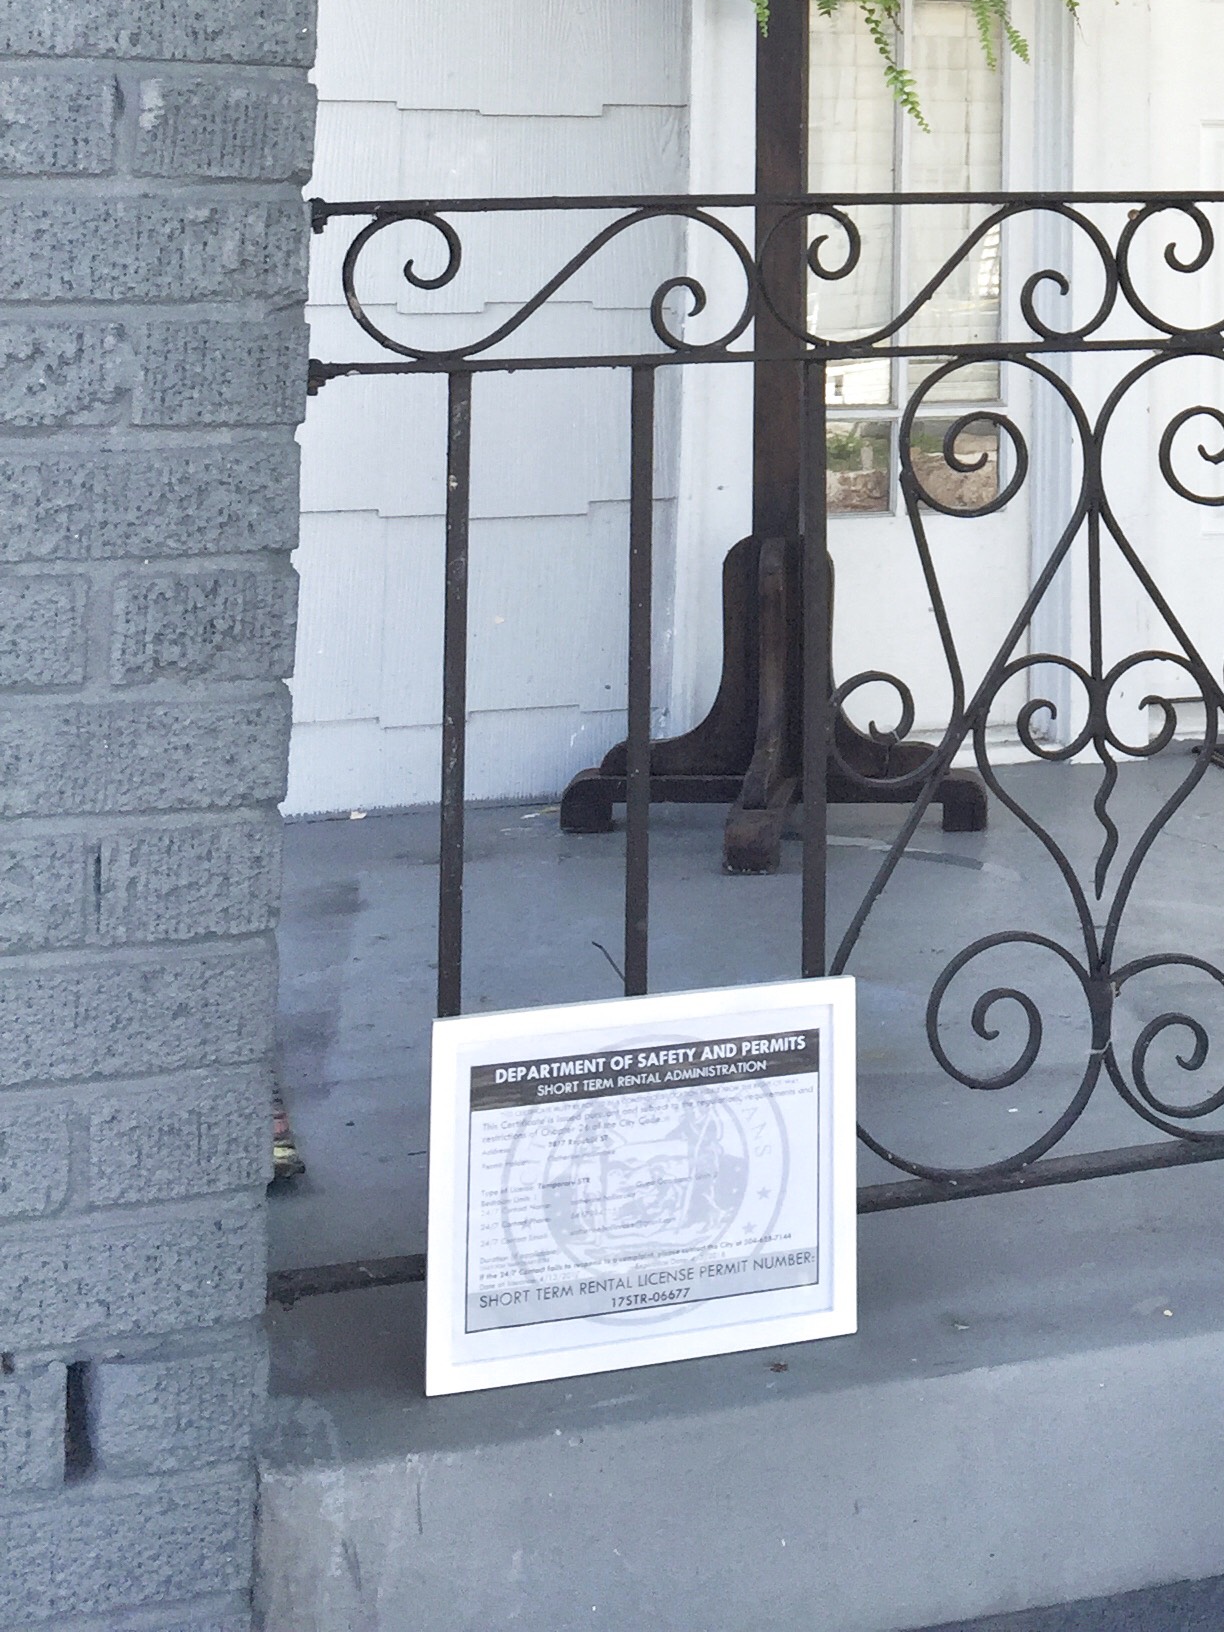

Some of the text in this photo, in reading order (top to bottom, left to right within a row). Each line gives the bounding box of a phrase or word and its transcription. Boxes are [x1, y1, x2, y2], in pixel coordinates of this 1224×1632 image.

[495, 1035, 806, 1084] DEPARTMENT OF SAFETY AND PERMITS
[537, 1081, 580, 1097] SHORT
[583, 1077, 614, 1092] TERM
[617, 1072, 662, 1088] RENTAL
[664, 1060, 767, 1082] ADMINISTRATION
[479, 1251, 816, 1309] SHORT TERM RENTAL LICENSE PERMIT NUMBER:
[611, 1287, 691, 1308] 17STR-06677
